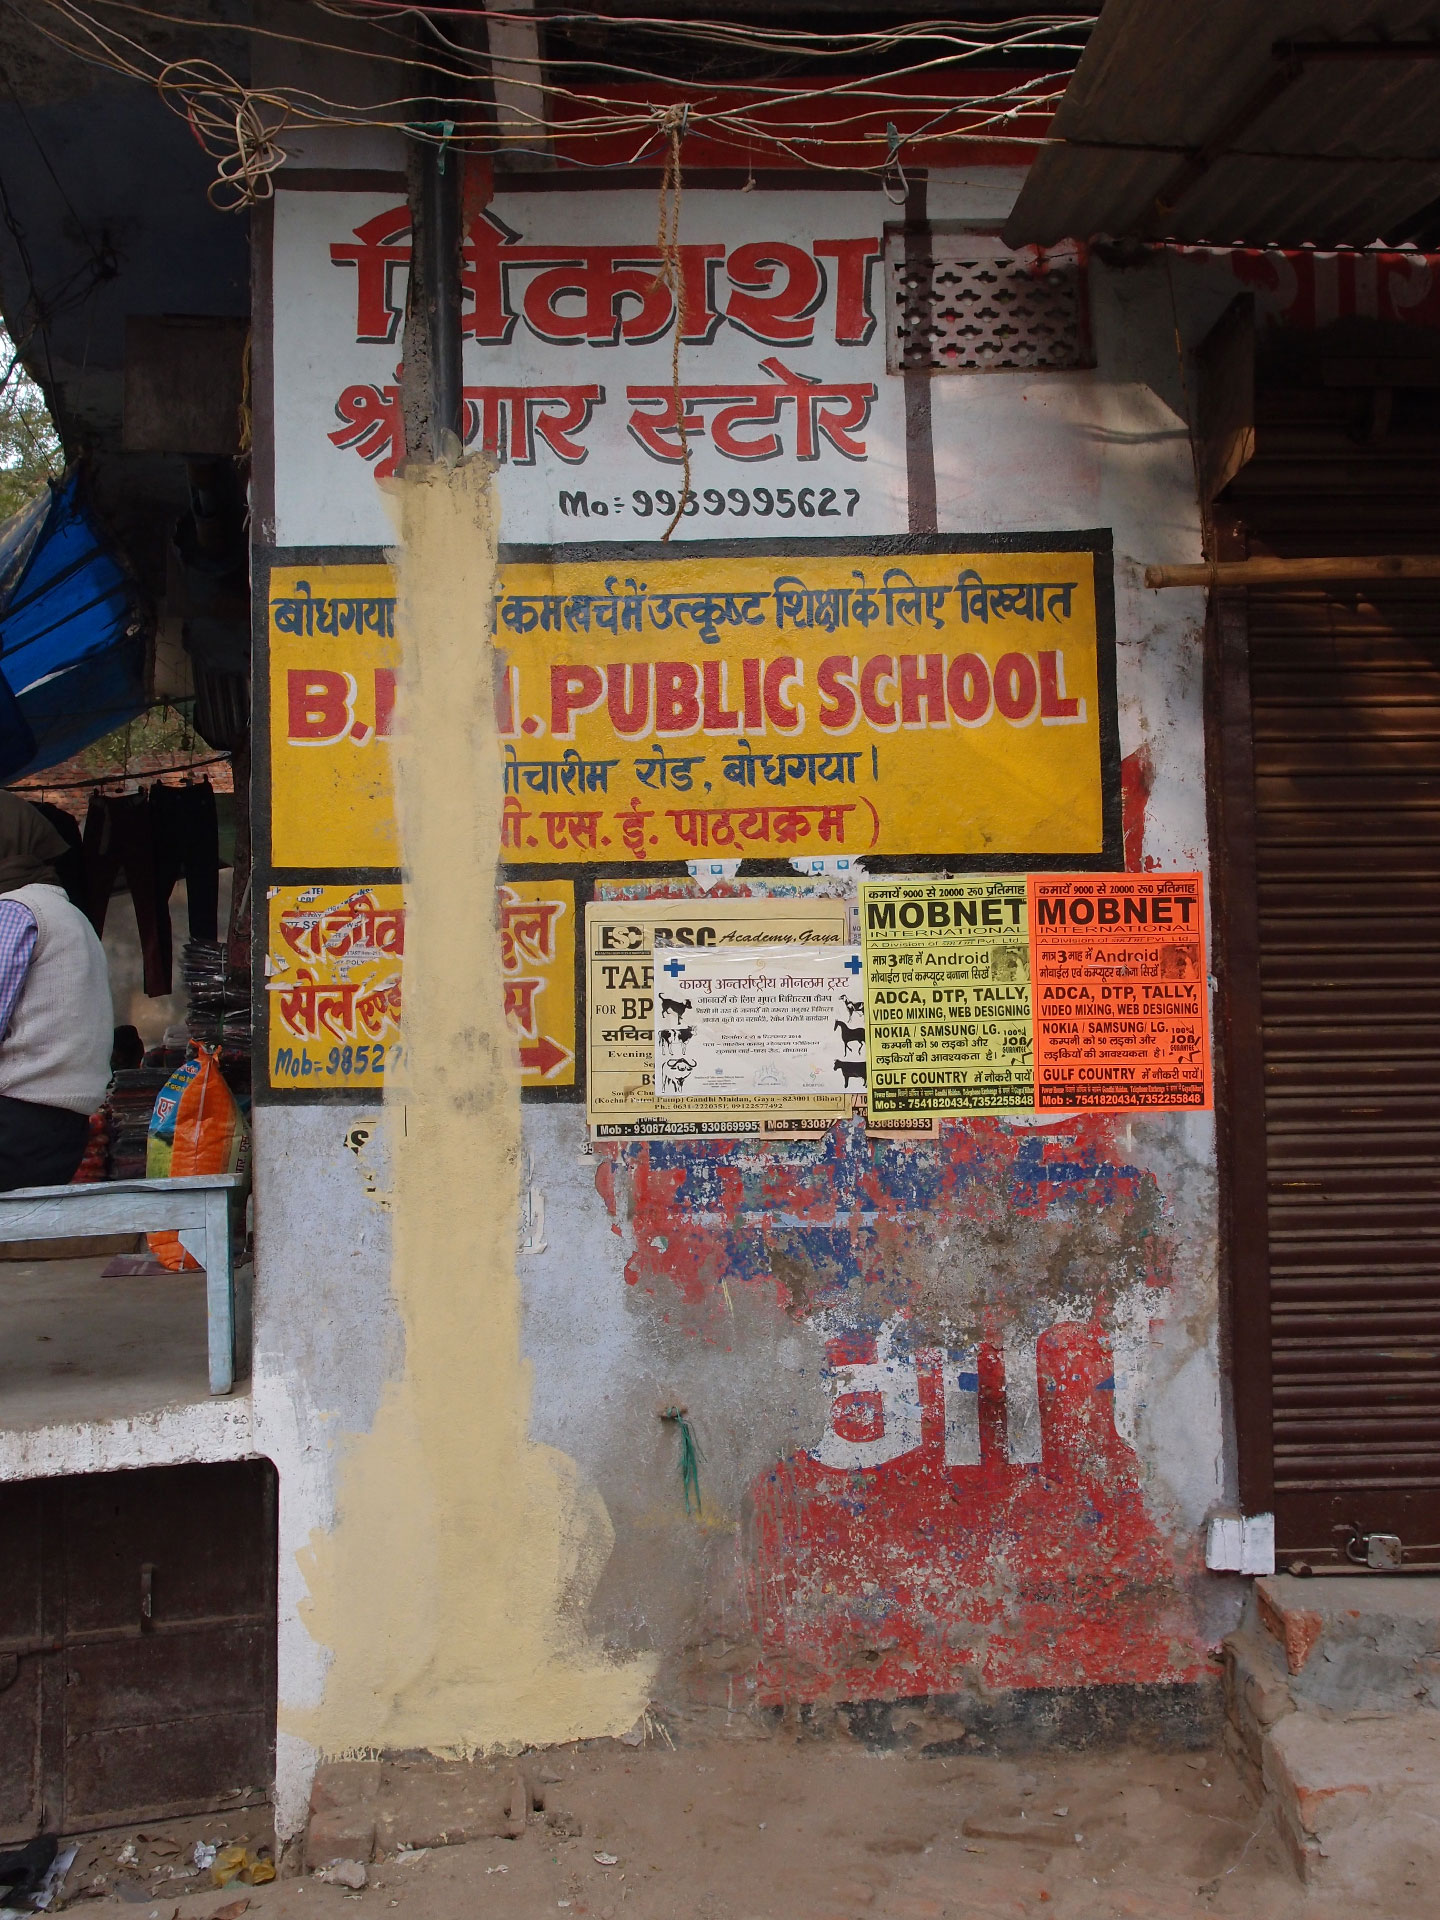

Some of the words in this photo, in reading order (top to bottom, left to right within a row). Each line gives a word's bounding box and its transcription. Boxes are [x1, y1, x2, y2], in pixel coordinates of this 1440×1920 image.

[626, 356, 879, 462] स्टोर
[632, 487, 860, 518] 9939995627
[955, 568, 1077, 625] विख्यात
[551, 656, 805, 741] PUBLIC
[816, 650, 1087, 737] SCHOOL
[903, 888, 923, 898] 9000
[926, 886, 936, 898] से
[939, 888, 964, 897] 20000
[985, 883, 1025, 897] प्रतिमाह
[1073, 885, 1094, 894] 9000
[1097, 883, 1106, 894] से
[1109, 885, 1134, 894] 20000
[1156, 880, 1195, 894] प्रतिमाह
[867, 898, 1027, 930] MOBNET
[1037, 896, 1197, 925] MOBNET
[719, 930, 798, 944] Academy,
[799, 929, 841, 944] Gaya
[870, 926, 1027, 938] INTERNATIONAL
[1040, 924, 1197, 934] INTERNATIONAL
[888, 954, 898, 967] 3
[915, 950, 924, 964] में
[925, 951, 989, 966] Android
[1057, 950, 1068, 963] 3
[1084, 947, 1093, 961] में
[1094, 949, 1159, 963] Android
[780, 975, 824, 990] मोनलम
[827, 977, 850, 991] ट्रस्ट
[874, 990, 926, 1006] ADCA,
[932, 989, 968, 1005] DTP,
[973, 986, 1029, 1003] TALLY,
[1043, 986, 1095, 1002] ADCA,
[1101, 986, 1137, 1002] DTP,
[1142, 985, 1197, 1001] TALLY,
[279, 968, 360, 1042] सेल
[596, 1004, 616, 1015] FOR
[621, 998, 654, 1020] BP
[873, 1008, 903, 1021] VIDEO
[906, 1006, 946, 1021] MIXING,
[949, 1006, 971, 1018] WEB
[974, 1004, 1030, 1018] DESIGNING
[1041, 1004, 1072, 1016] VIDEO
[1075, 1003, 1115, 1017] MIXING,
[1117, 1003, 1140, 1015] WEB
[1143, 1002, 1199, 1015] DESIGNING
[602, 1025, 655, 1041] सचिव
[874, 1026, 911, 1039] NOKIA
[982, 1023, 1001, 1035] LG.
[1043, 1022, 1079, 1034] NOKIA
[1151, 1021, 1169, 1033] LG.
[914, 1038, 927, 1048] को
[929, 1040, 939, 1048] 50
[1002, 1036, 1027, 1046] JOB
[1083, 1035, 1095, 1045] को
[1098, 1037, 1107, 1045] 50
[1170, 1035, 1195, 1044] JOB
[608, 1051, 652, 1060] Evening
[916, 1051, 928, 1062] की
[931, 1052, 981, 1062] आवश्यकता
[1084, 1048, 1096, 1058] की
[1099, 1050, 1148, 1058] आवश्यकता
[876, 1072, 907, 1085] GULF
[911, 1071, 968, 1084] COUNTRY
[974, 1071, 984, 1083] में
[1043, 1068, 1074, 1081] GULF
[1078, 1067, 1136, 1081] COUNTRY
[1141, 1067, 1151, 1080] में
[754, 1096, 775, 1104] Gaya
[812, 1095, 842, 1103] (Bihar)
[875, 1100, 896, 1110] Mob
[1042, 1095, 1064, 1105] Mob
[600, 1124, 622, 1135] Mob
[633, 1122, 699, 1134] 9308740255,
[767, 1120, 789, 1130] Mob
